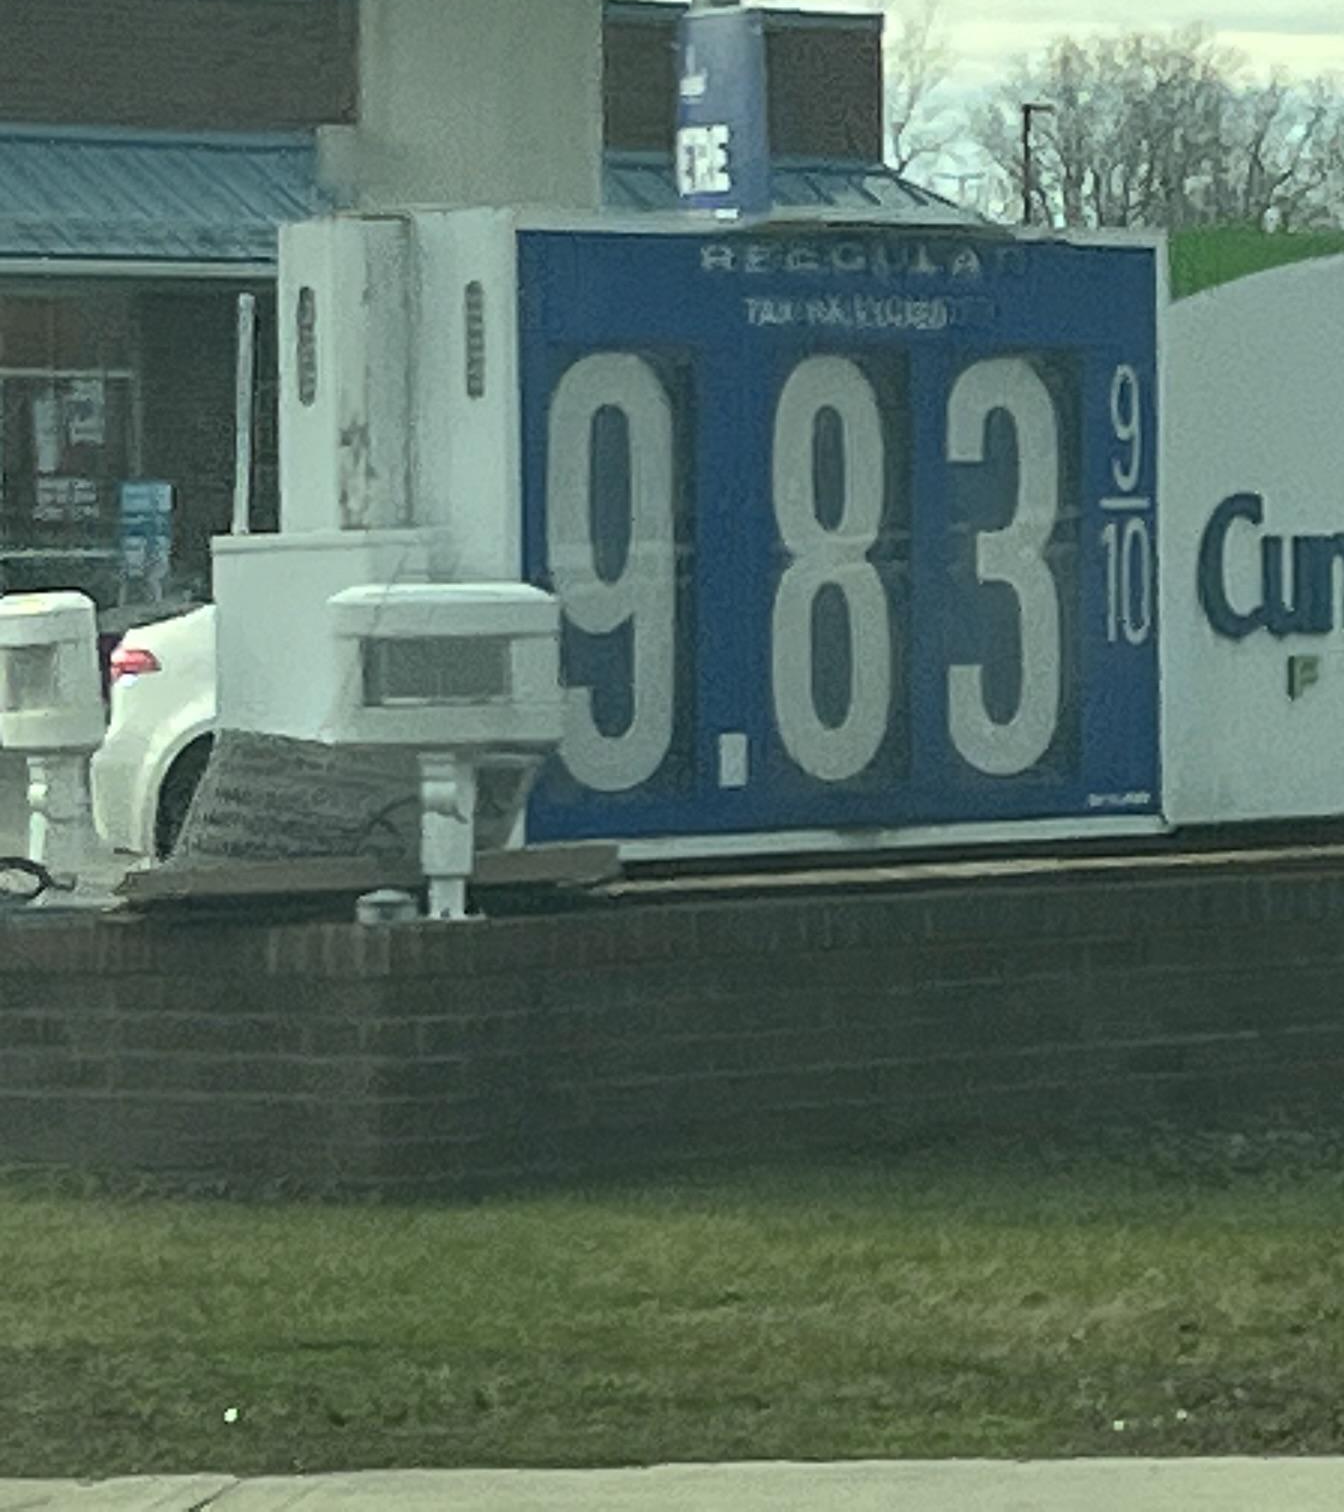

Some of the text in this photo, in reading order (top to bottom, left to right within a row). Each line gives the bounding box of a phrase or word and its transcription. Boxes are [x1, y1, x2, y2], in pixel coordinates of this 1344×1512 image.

[700, 242, 1026, 274] REGULA
[1110, 364, 1140, 491] 9
[1103, 517, 1150, 645] 10
